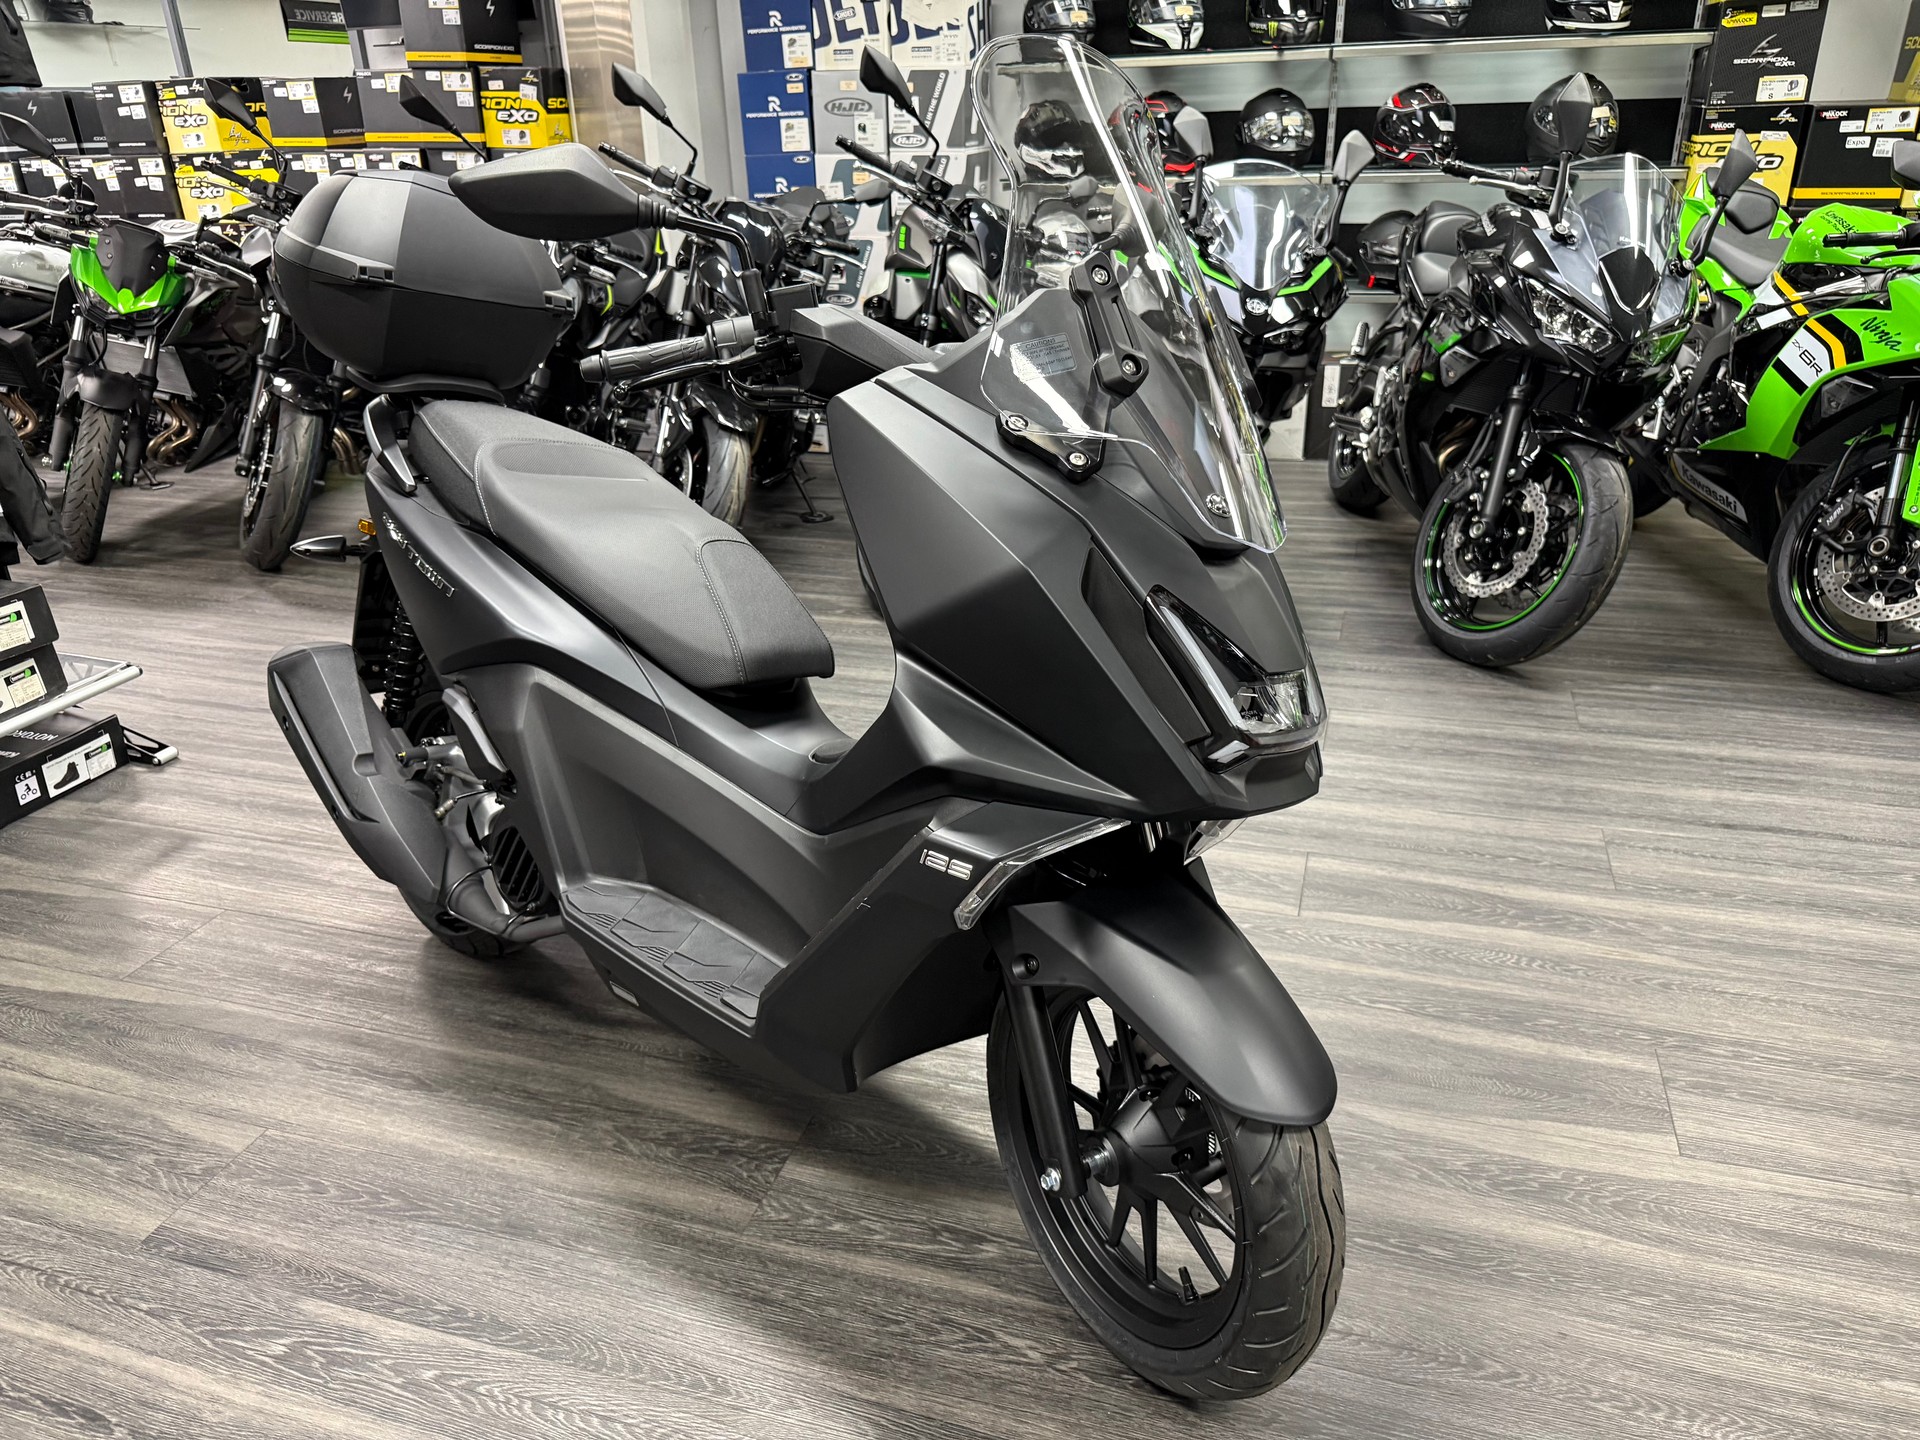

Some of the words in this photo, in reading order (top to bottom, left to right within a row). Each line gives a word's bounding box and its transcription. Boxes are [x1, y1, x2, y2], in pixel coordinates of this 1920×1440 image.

[474, 43, 503, 51] SCORPION
[1733, 56, 1788, 65] SCORPION
[933, 71, 946, 100] WORLD
[547, 97, 568, 109] SC
[830, 102, 866, 112] HJC
[174, 114, 208, 127] EXO
[497, 109, 538, 123] EXO
[1875, 123, 1884, 131] M
[936, 157, 947, 178] ORLD
[190, 186, 224, 199] EXO
[1859, 316, 1902, 352] Ninja
[1681, 464, 1738, 513] Kawasaki
[919, 848, 974, 881] 125
